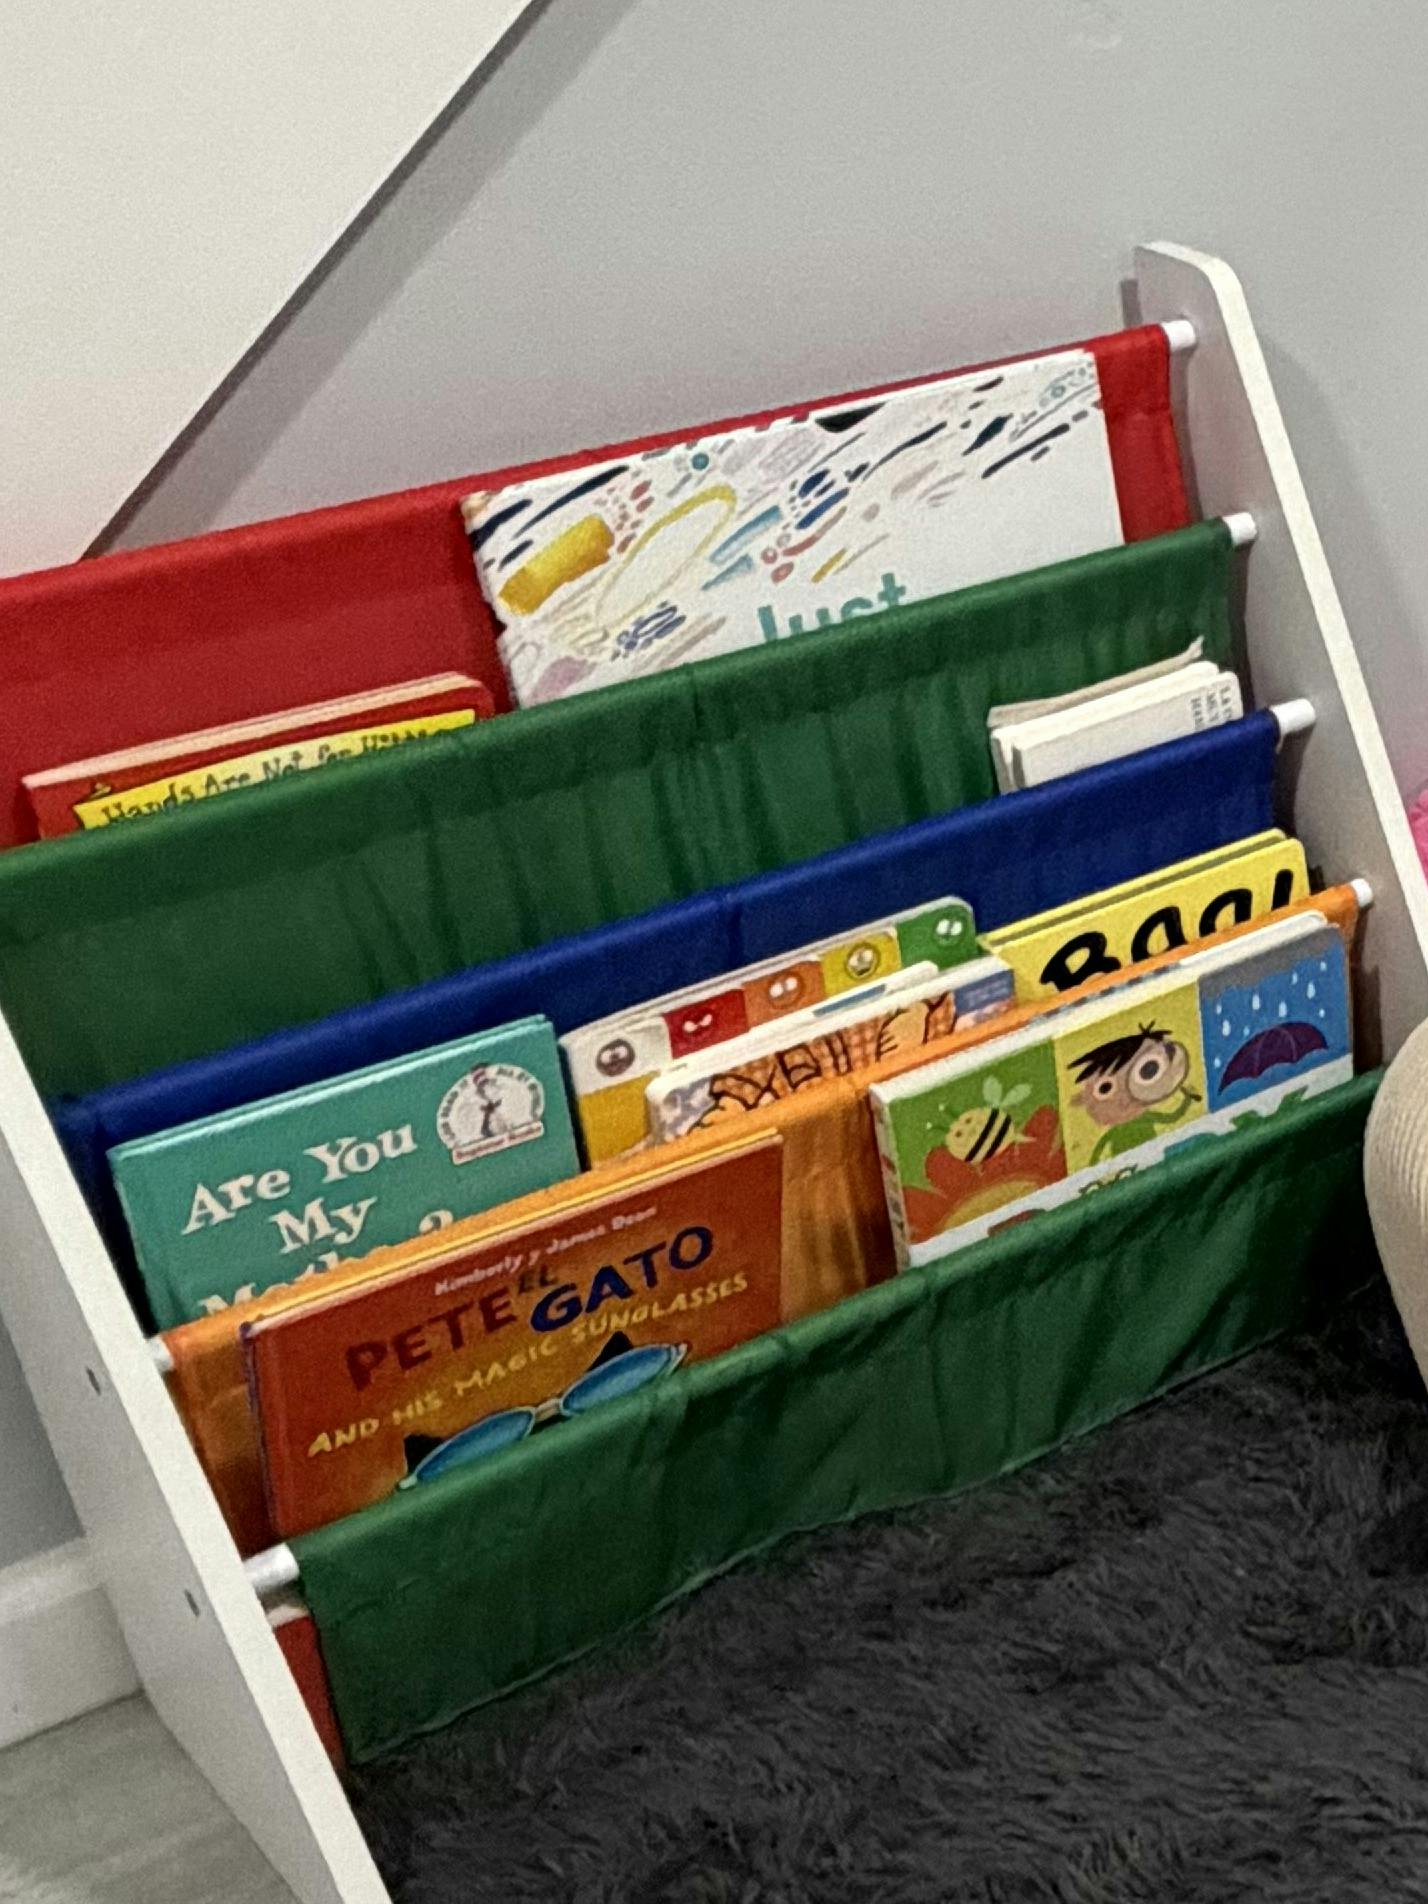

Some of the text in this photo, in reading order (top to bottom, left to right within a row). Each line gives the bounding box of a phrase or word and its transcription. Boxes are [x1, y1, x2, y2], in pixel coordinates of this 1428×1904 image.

[181, 1168, 291, 1235] Are
[303, 1124, 418, 1184] You
[270, 1197, 378, 1255] My
[434, 1252, 525, 1295] Kimberly
[516, 1264, 561, 1295] EL
[529, 1226, 714, 1333] GATO
[307, 1271, 750, 1459] AND HIS MAGIC SUNGLASSES
[345, 1287, 518, 1392] PETE
